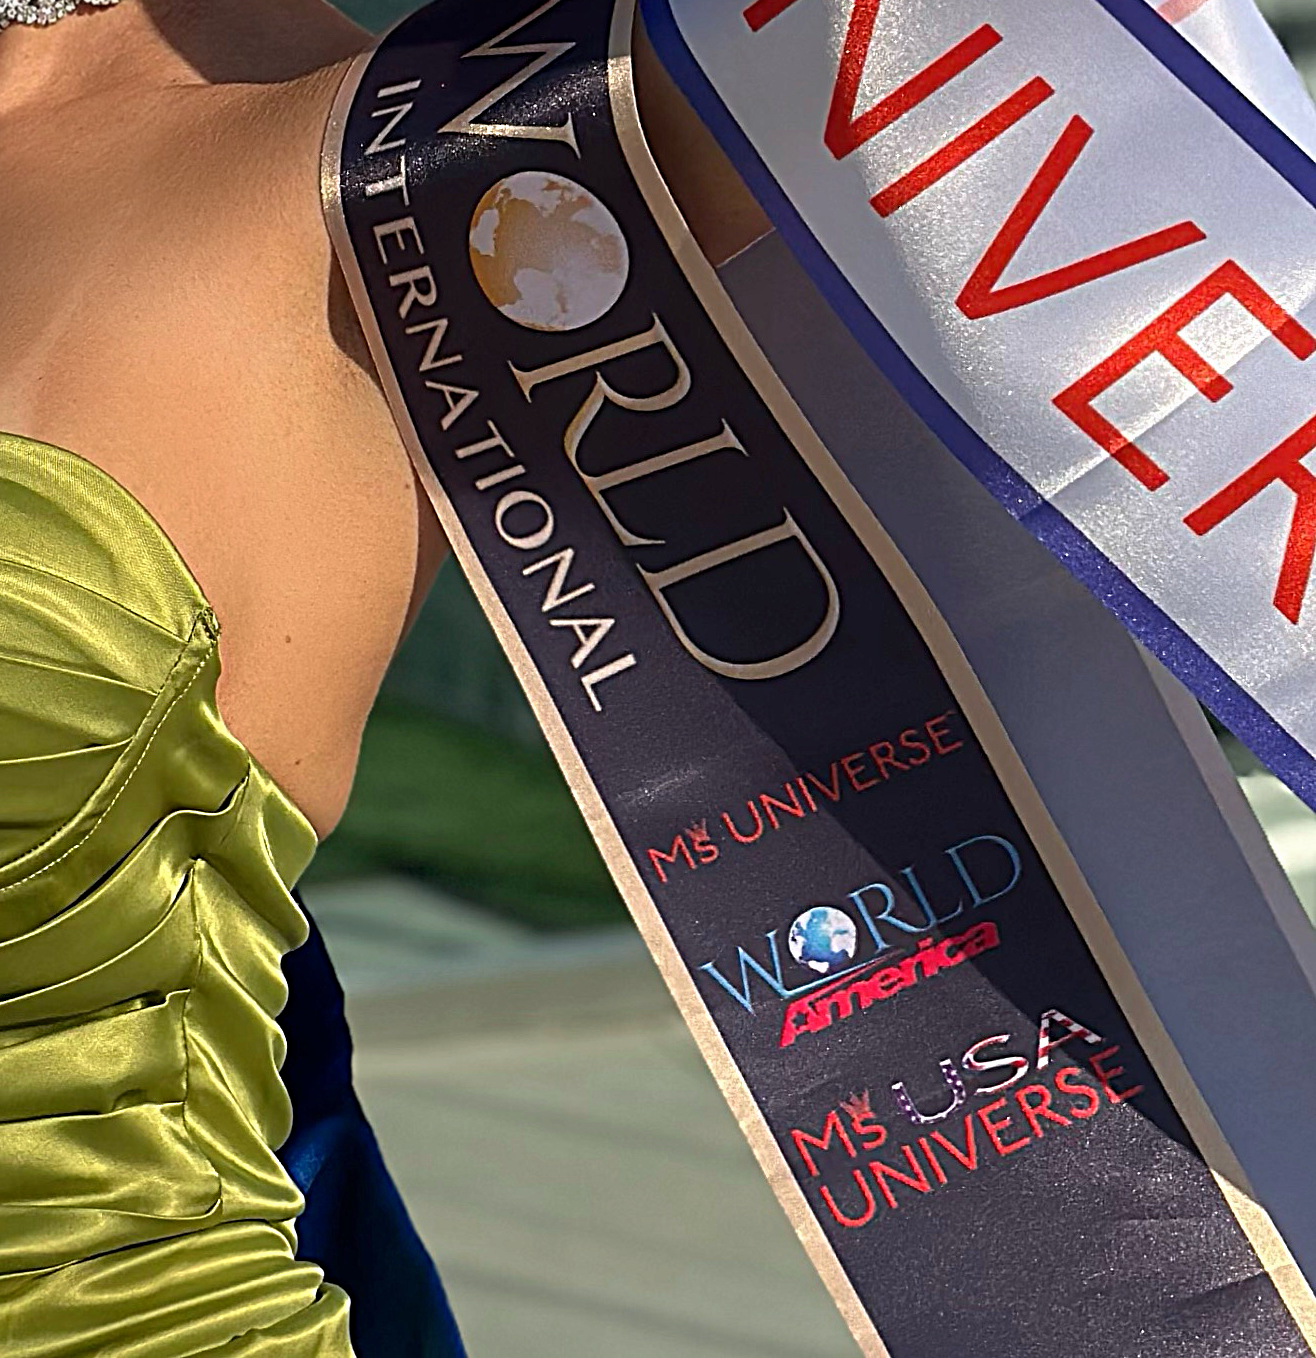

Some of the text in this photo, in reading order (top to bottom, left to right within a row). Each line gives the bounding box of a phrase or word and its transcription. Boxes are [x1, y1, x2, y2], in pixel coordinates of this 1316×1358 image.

[363, 78, 637, 712] INTERNATIONAL
[647, 715, 964, 884] Ms UNIVERSE
[779, 922, 1000, 1048] America
[790, 1008, 1106, 1177] Ms USA
[820, 1045, 1143, 1229] UNIVERSE
